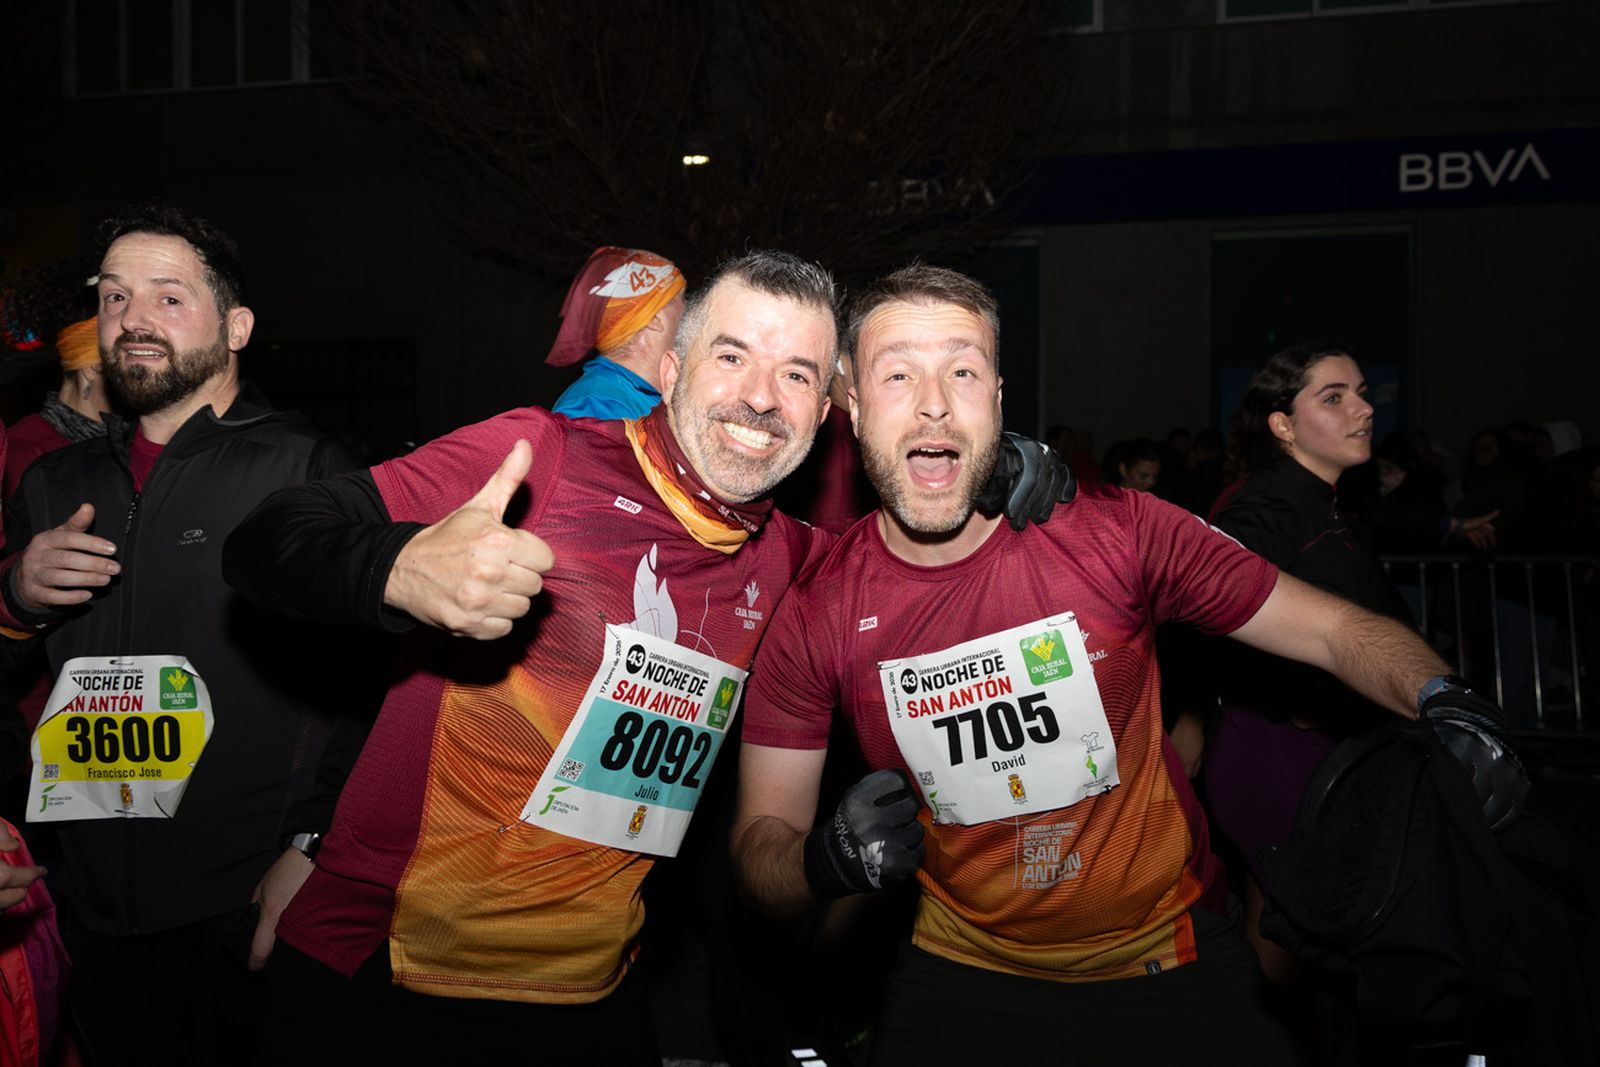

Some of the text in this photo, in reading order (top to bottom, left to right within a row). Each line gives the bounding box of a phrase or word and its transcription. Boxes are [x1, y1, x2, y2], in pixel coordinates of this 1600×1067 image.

[1399, 143, 1551, 192] BBVA
[629, 266, 656, 292] 43
[627, 650, 645, 668] 43
[649, 651, 668, 663] CARRERA
[918, 647, 1001, 675] CARRERA URBANA INTERNACIONAL
[1088, 649, 1108, 662] RAL
[123, 675, 144, 690] DE
[642, 660, 709, 697] NOCHE DE
[901, 673, 917, 688] 43
[920, 655, 1006, 693] NOCHE DE
[63, 691, 144, 713] AN ANTÓN
[611, 679, 652, 708] SAN
[647, 691, 702, 723] ANTÓN
[907, 675, 1013, 719] SAN ANTÓN
[66, 715, 181, 763] 3600
[932, 691, 1061, 767] 7705
[599, 711, 712, 789] 8092
[87, 766, 162, 779] Francisco Jose
[991, 753, 1027, 773] David
[634, 784, 660, 801] Julio
[1023, 846, 1060, 864] SAN
